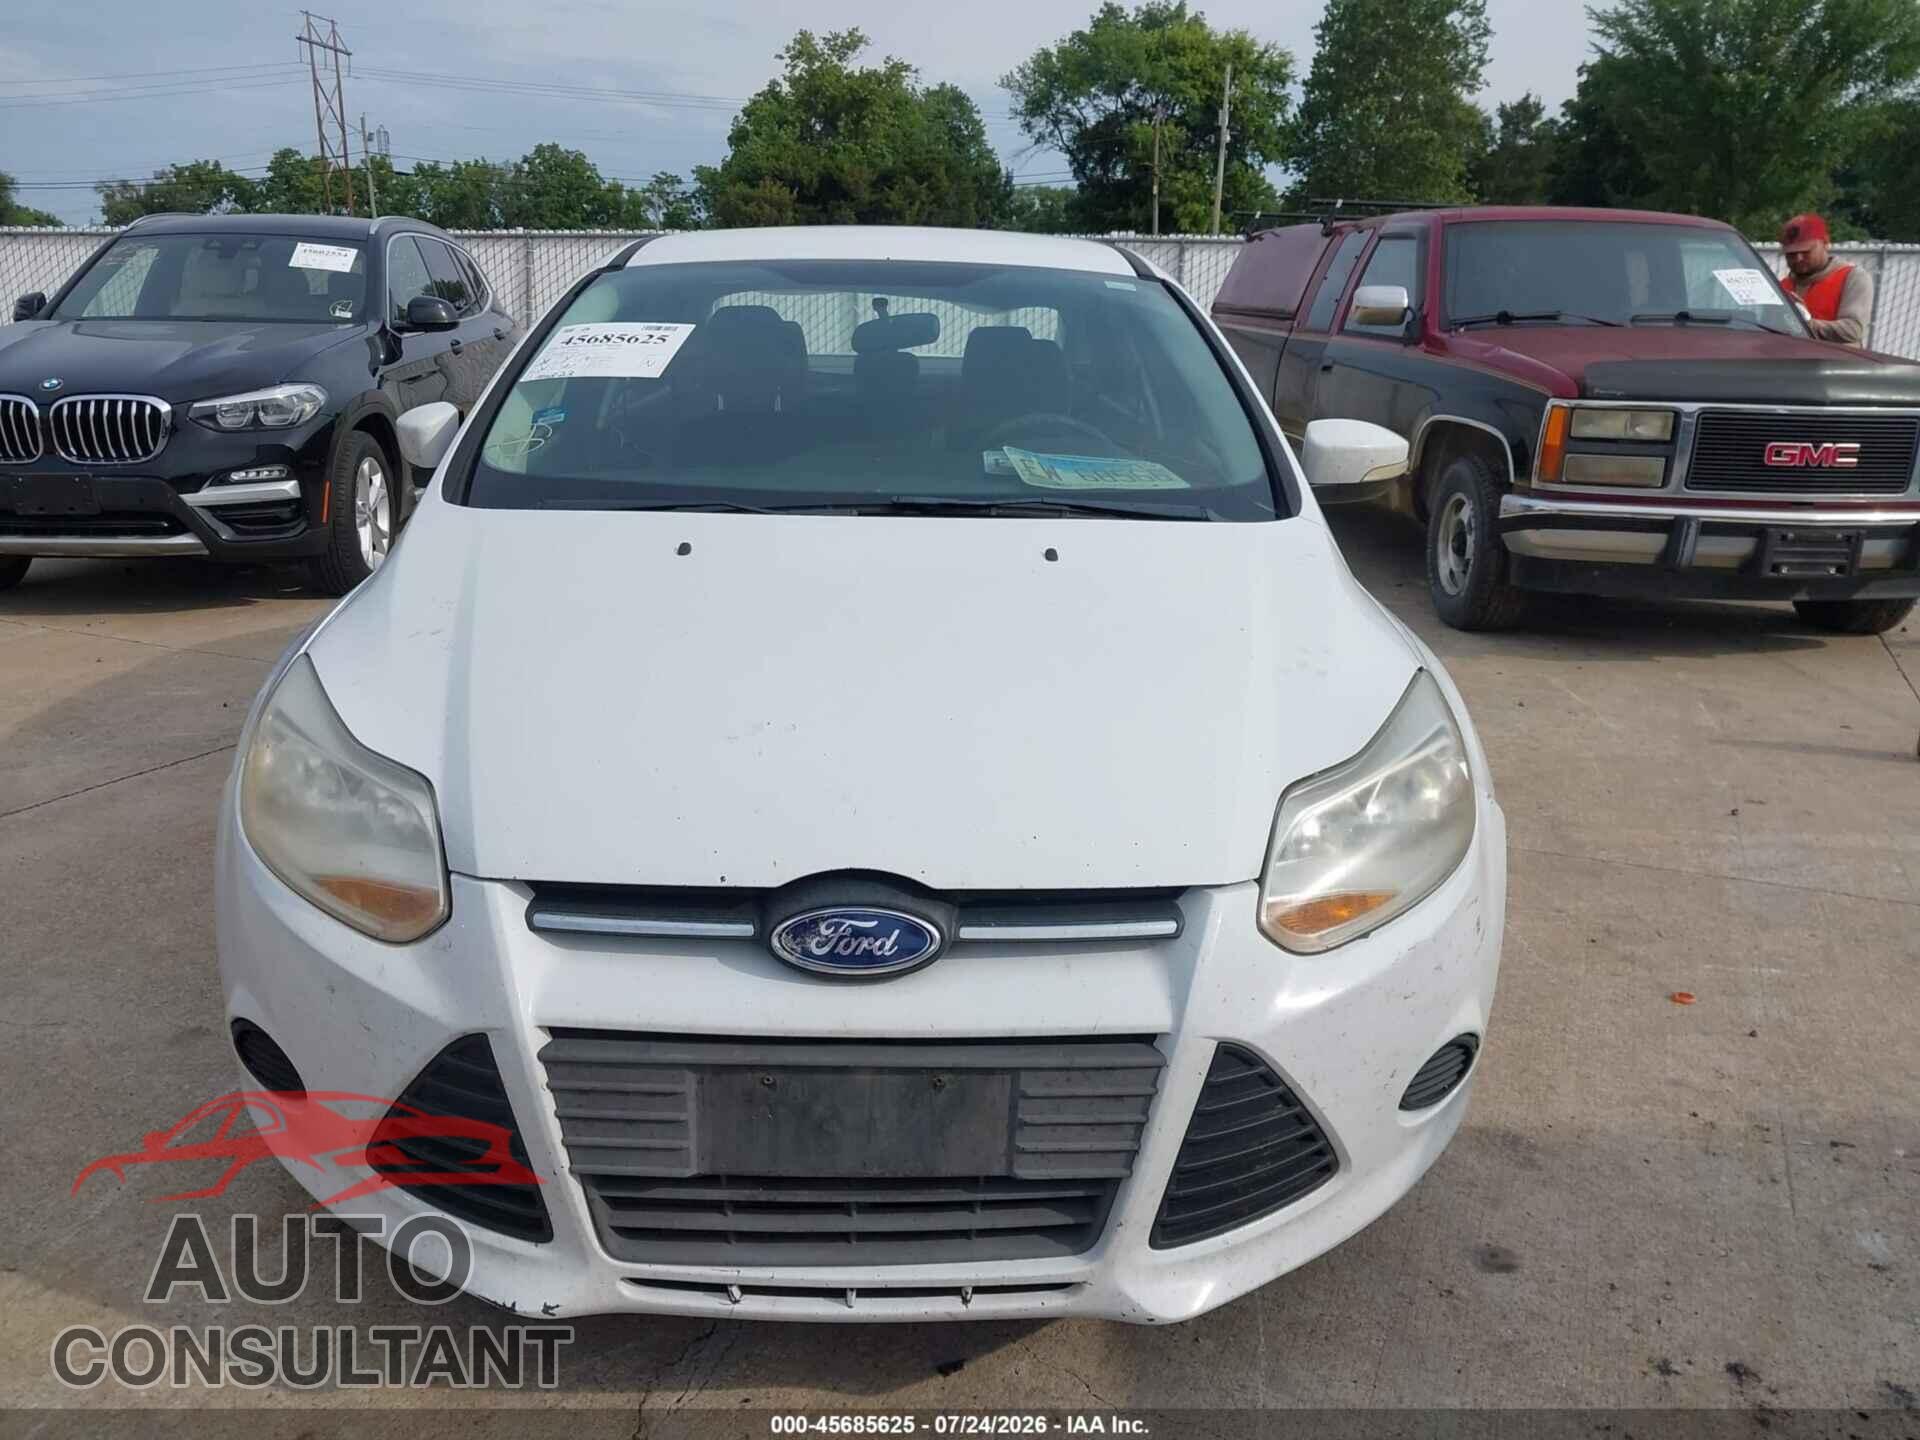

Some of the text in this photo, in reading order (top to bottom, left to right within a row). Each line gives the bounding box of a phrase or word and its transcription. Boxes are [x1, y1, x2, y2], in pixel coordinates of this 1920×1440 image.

[560, 333, 670, 346] 45685625
[1764, 442, 1860, 467] GMC
[810, 918, 900, 955] Ford
